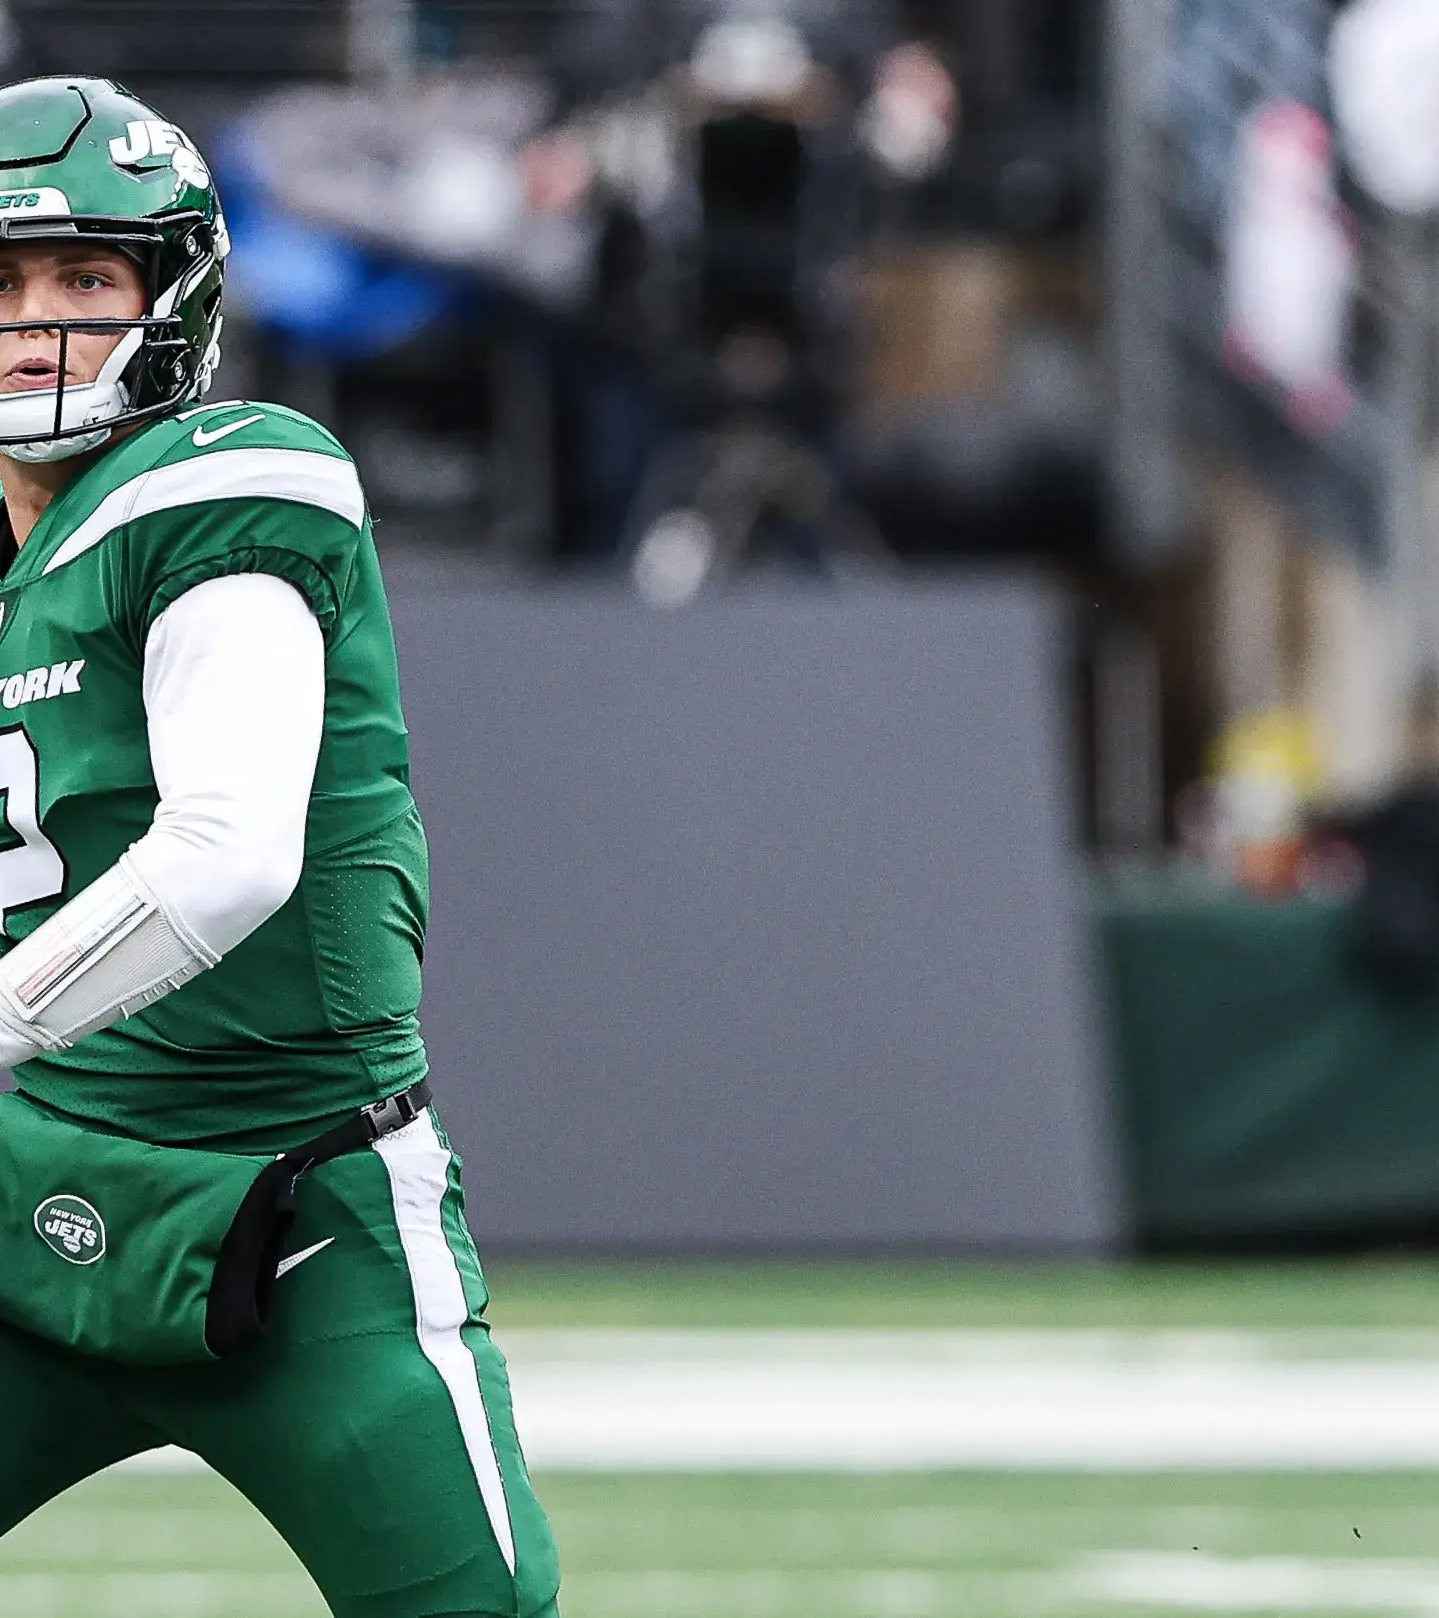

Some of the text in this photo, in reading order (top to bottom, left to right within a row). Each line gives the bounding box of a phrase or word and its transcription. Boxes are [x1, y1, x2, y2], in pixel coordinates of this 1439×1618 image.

[49, 1207, 94, 1229] NEW YORK
[44, 1219, 98, 1247] JETS
